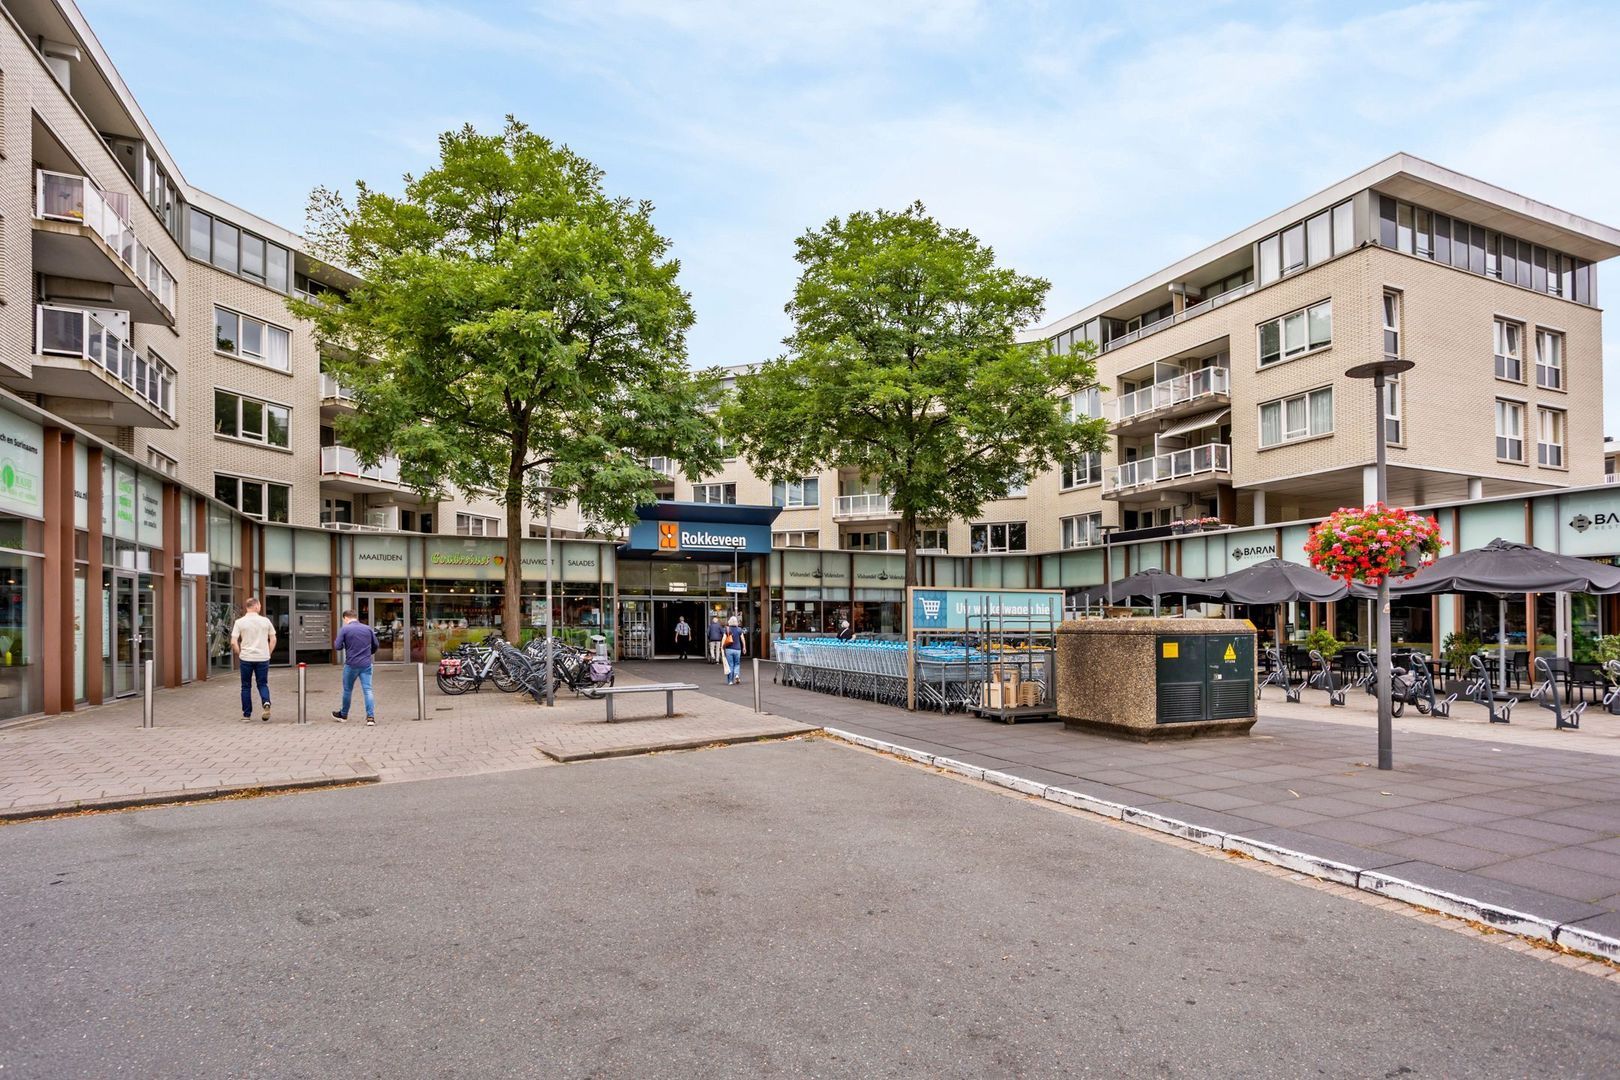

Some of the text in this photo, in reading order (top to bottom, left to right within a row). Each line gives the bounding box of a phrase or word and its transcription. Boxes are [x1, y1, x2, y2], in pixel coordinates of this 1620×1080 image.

[7, 437, 14, 445] en
[14, 438, 38, 455] Surinaams
[681, 531, 746, 547] Rokkeveen
[1243, 545, 1275, 556] BARAN
[358, 553, 403, 562] MAALTIJDEN
[567, 559, 596, 567] SALADES
